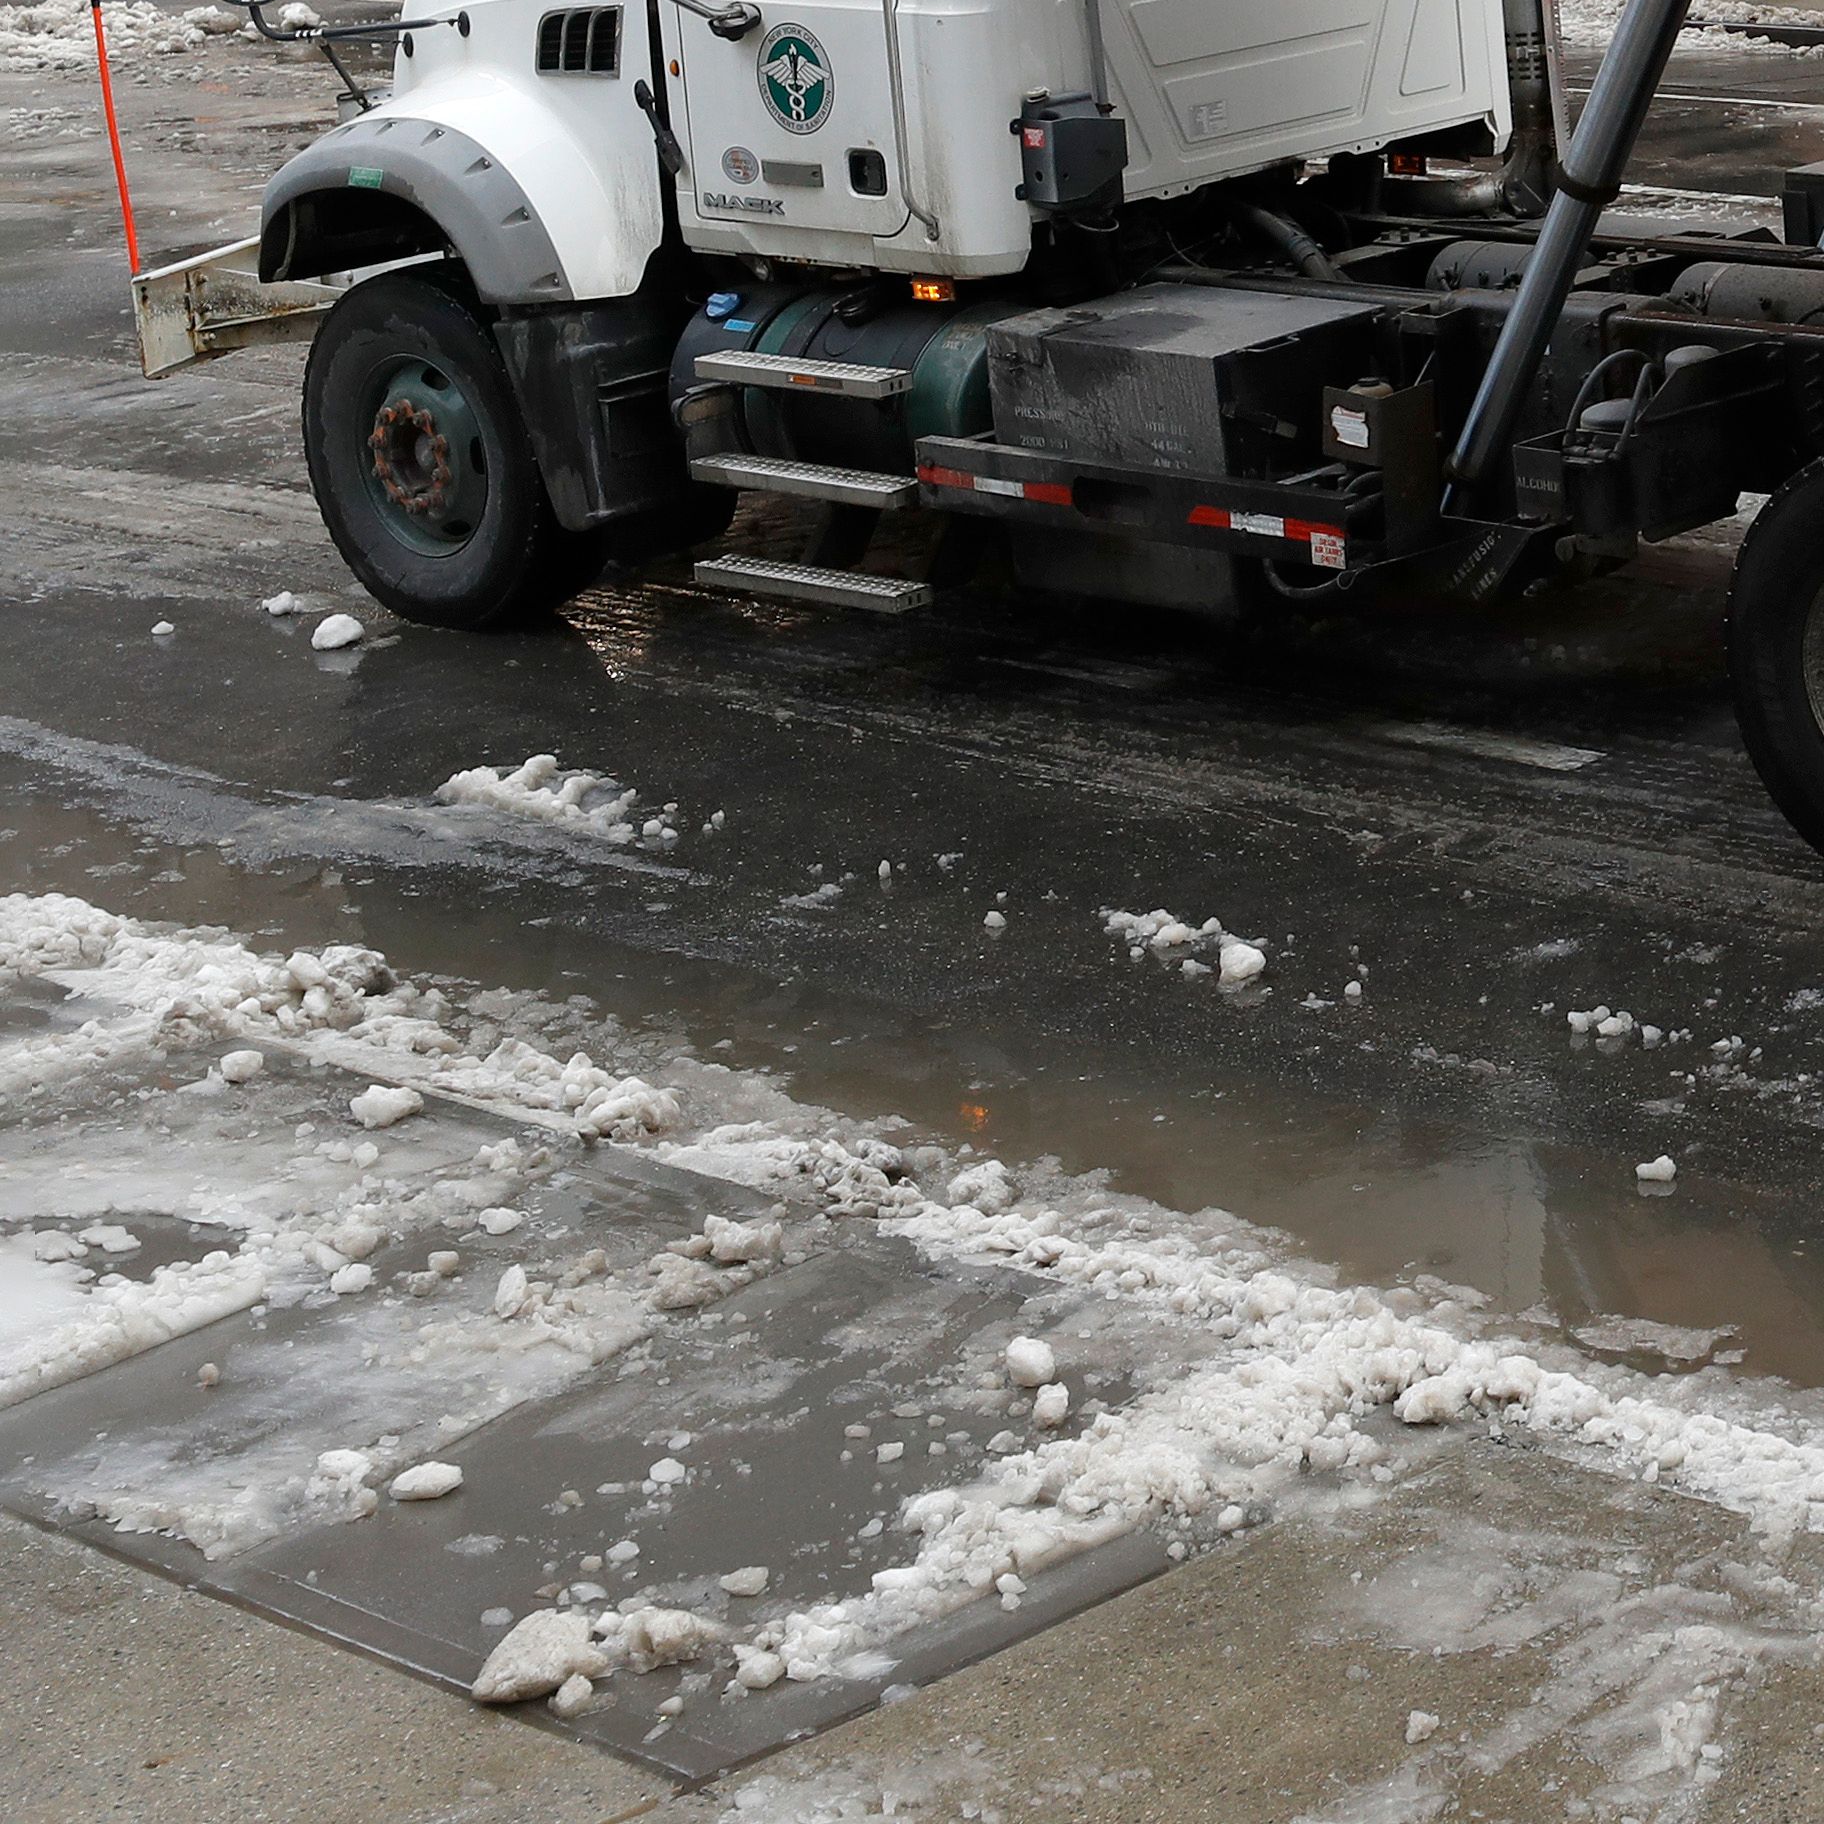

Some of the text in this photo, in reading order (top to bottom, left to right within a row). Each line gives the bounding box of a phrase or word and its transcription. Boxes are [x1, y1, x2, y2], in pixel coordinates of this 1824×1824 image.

[767, 27, 820, 50] NEW YORK CITY
[761, 84, 795, 130] DEPARTMENT
[805, 88, 832, 130] SANITATION
[703, 192, 786, 216] MACK
[1517, 476, 1560, 493] ALCOHO
